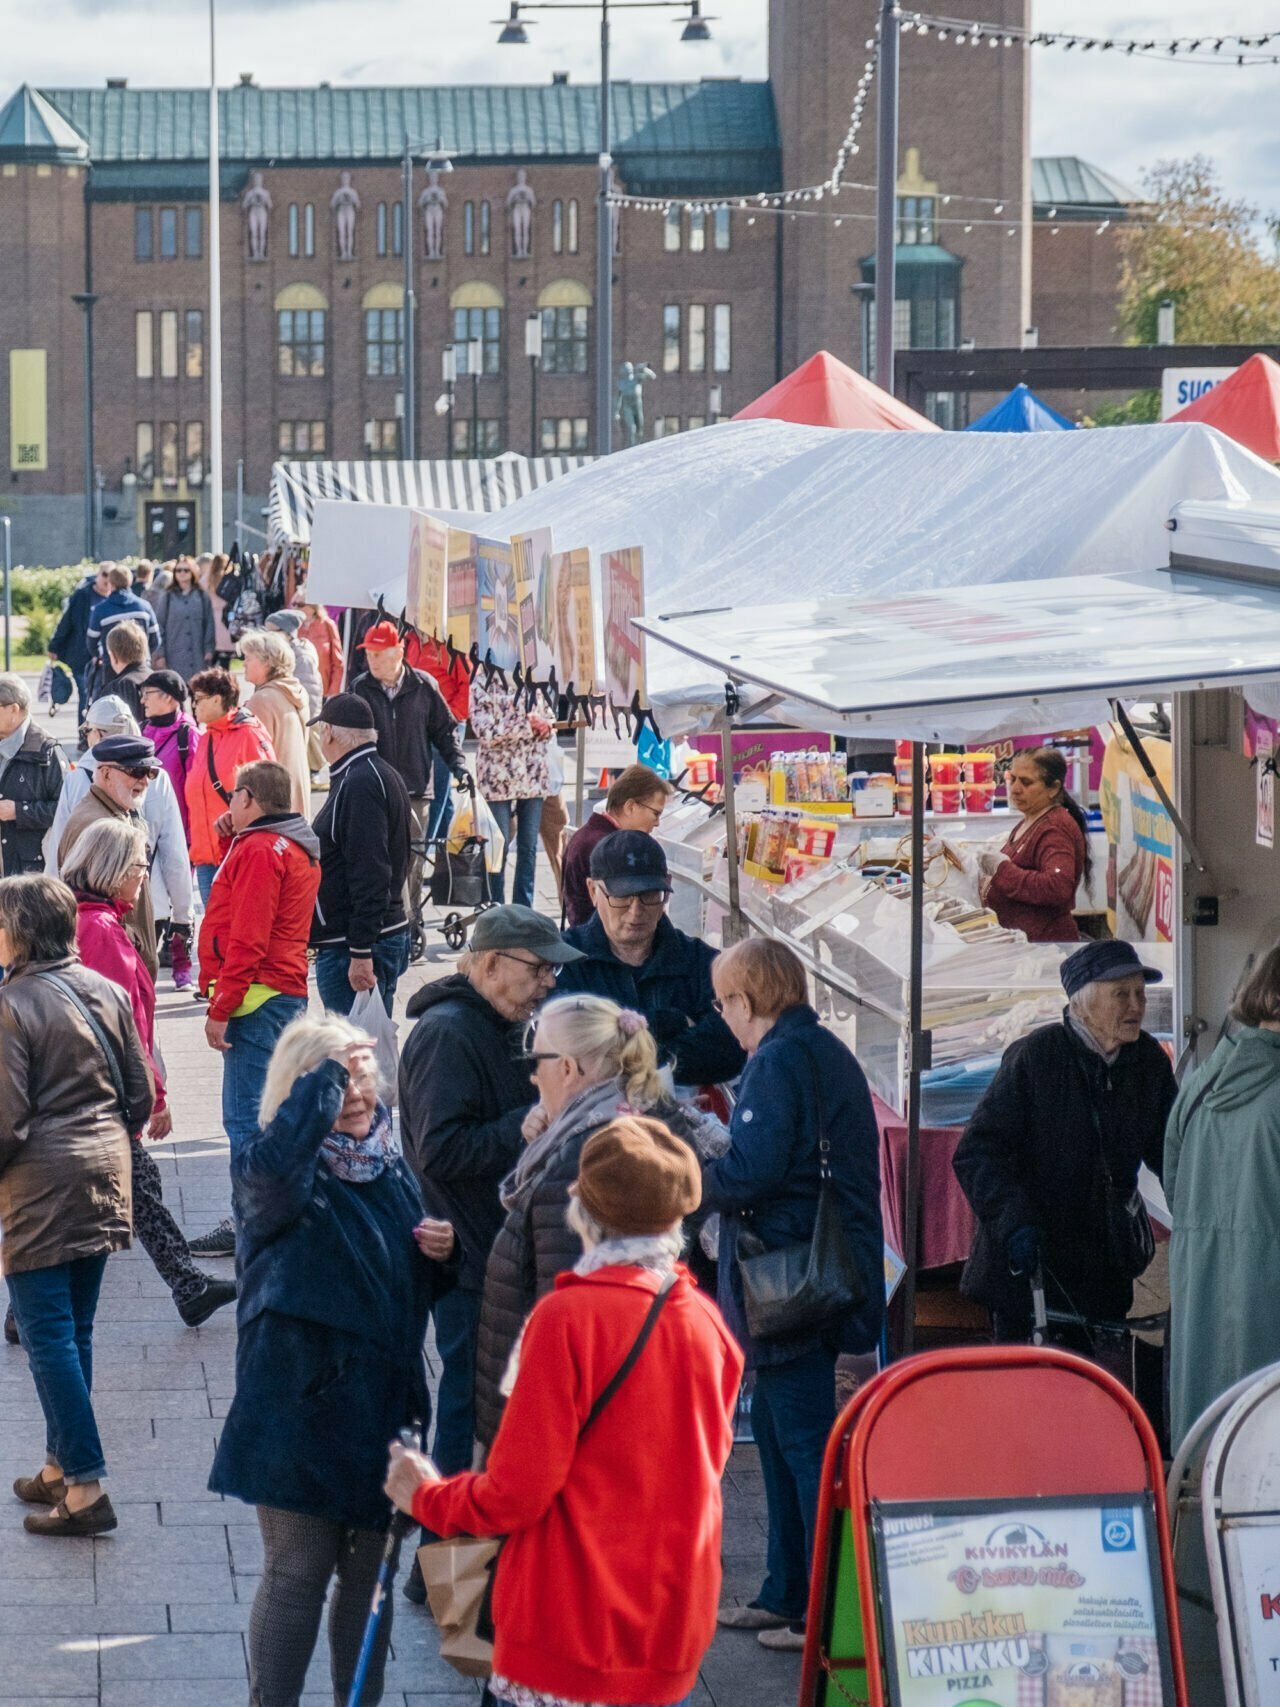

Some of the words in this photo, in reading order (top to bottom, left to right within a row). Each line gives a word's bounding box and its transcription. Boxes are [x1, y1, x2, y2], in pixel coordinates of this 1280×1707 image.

[964, 1543, 1069, 1561] KIVIKYLÄN
[902, 1610, 1027, 1646] Kunkku
[907, 1638, 1031, 1679] KINKKU
[946, 1674, 994, 1692] PIZZA
